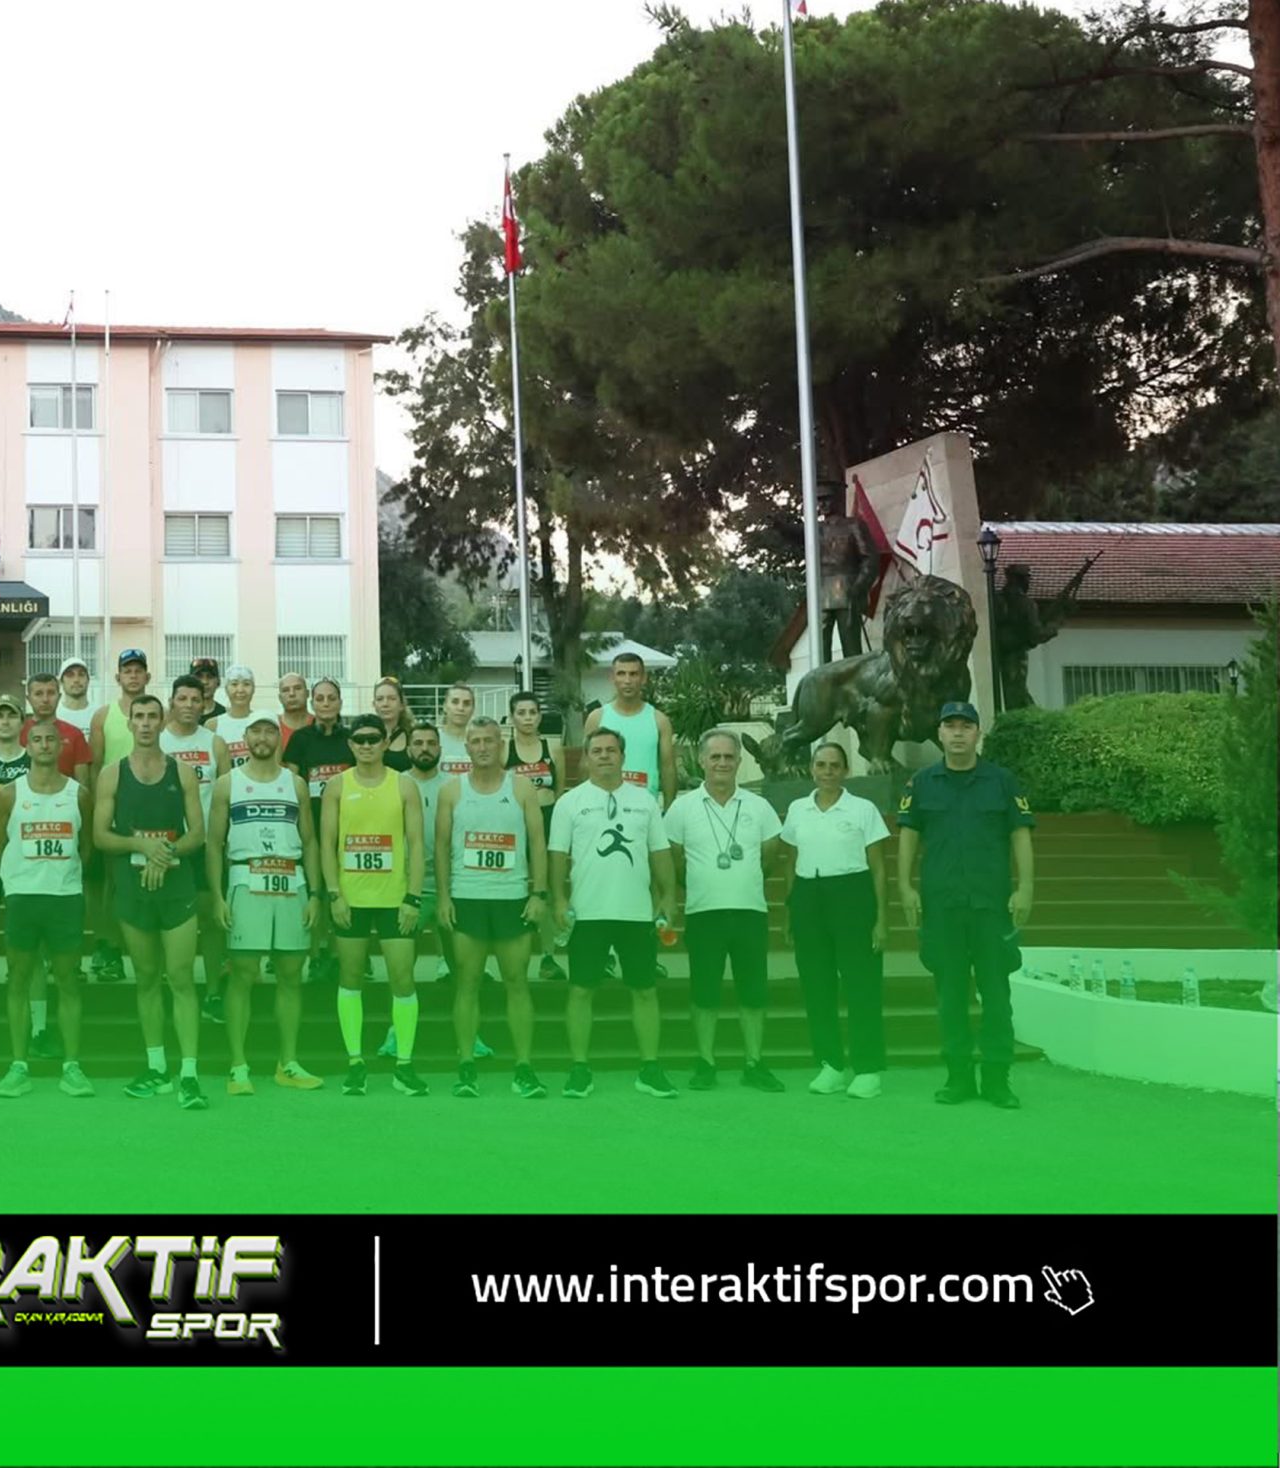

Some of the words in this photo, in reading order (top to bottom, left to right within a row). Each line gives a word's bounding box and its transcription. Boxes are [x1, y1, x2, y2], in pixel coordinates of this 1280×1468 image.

[34, 840, 63, 856] 184
[354, 853, 383, 870] 185
[476, 850, 505, 868] 180
[262, 875, 289, 892] 190
